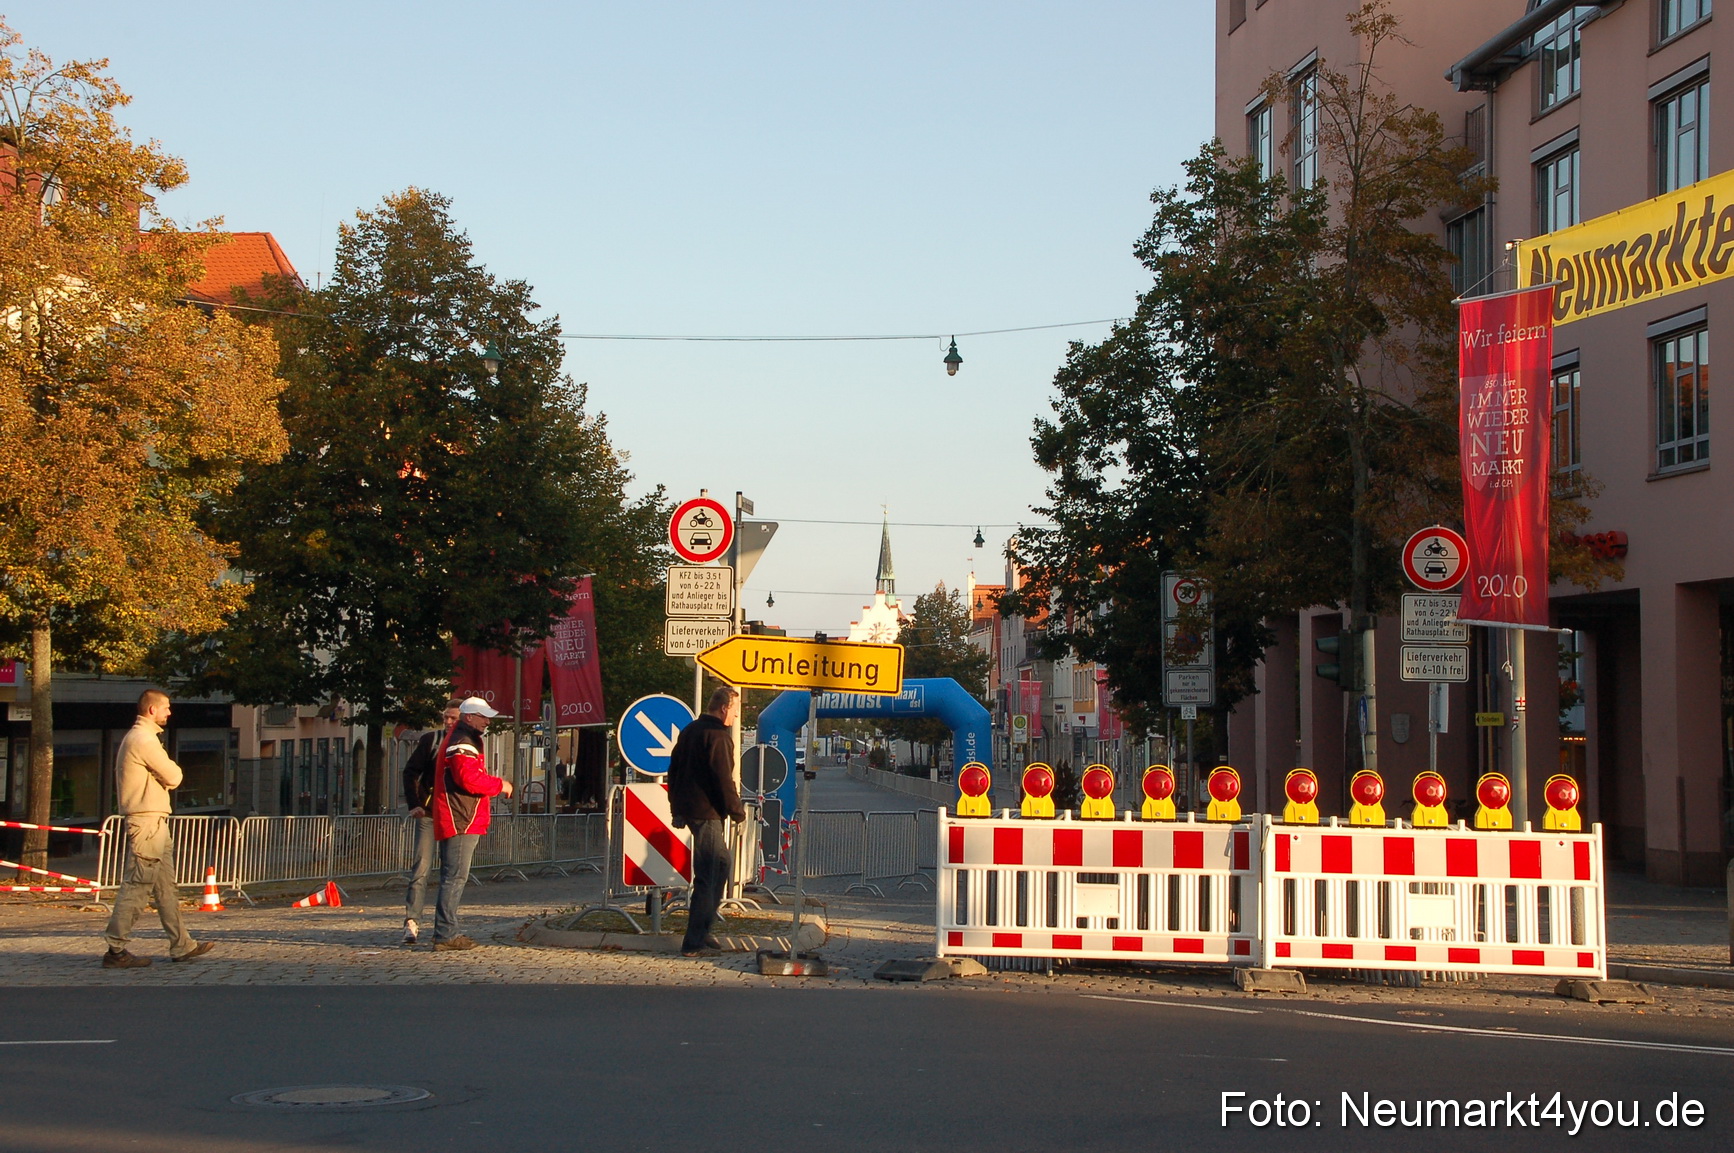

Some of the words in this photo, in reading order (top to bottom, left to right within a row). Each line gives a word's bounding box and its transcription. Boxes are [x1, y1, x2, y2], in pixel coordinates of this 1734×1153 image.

[1462, 329, 1492, 350] Wir
[1497, 324, 1547, 344] feiern
[1484, 380, 1498, 388] 850
[1470, 388, 1528, 409] IMMER
[1467, 408, 1530, 428] WIEDER
[1470, 429, 1524, 457] NEU
[1472, 459, 1524, 476] MARKT
[680, 572, 692, 580] KFZ
[694, 572, 704, 580] bis
[1478, 574, 1527, 598] 2010
[672, 592, 684, 600] und
[686, 592, 714, 601] Anlieger
[717, 592, 727, 600] bis
[671, 601, 713, 610] Rathausplatz
[716, 602, 728, 610] frei
[1422, 619, 1450, 628] Anlieger
[672, 626, 725, 636] Lieferverkehr
[1406, 628, 1449, 637] Rathausplatz
[553, 638, 585, 652] NEU
[705, 640, 710, 648] h
[555, 650, 586, 662] MARKT
[1407, 652, 1462, 662] Lieferverkehr
[741, 649, 879, 686] Umleitung
[1442, 665, 1447, 674] h
[1450, 666, 1464, 674] frei
[464, 690, 495, 702] 2010
[562, 702, 592, 716] 2010
[536, 736, 550, 747] WC
